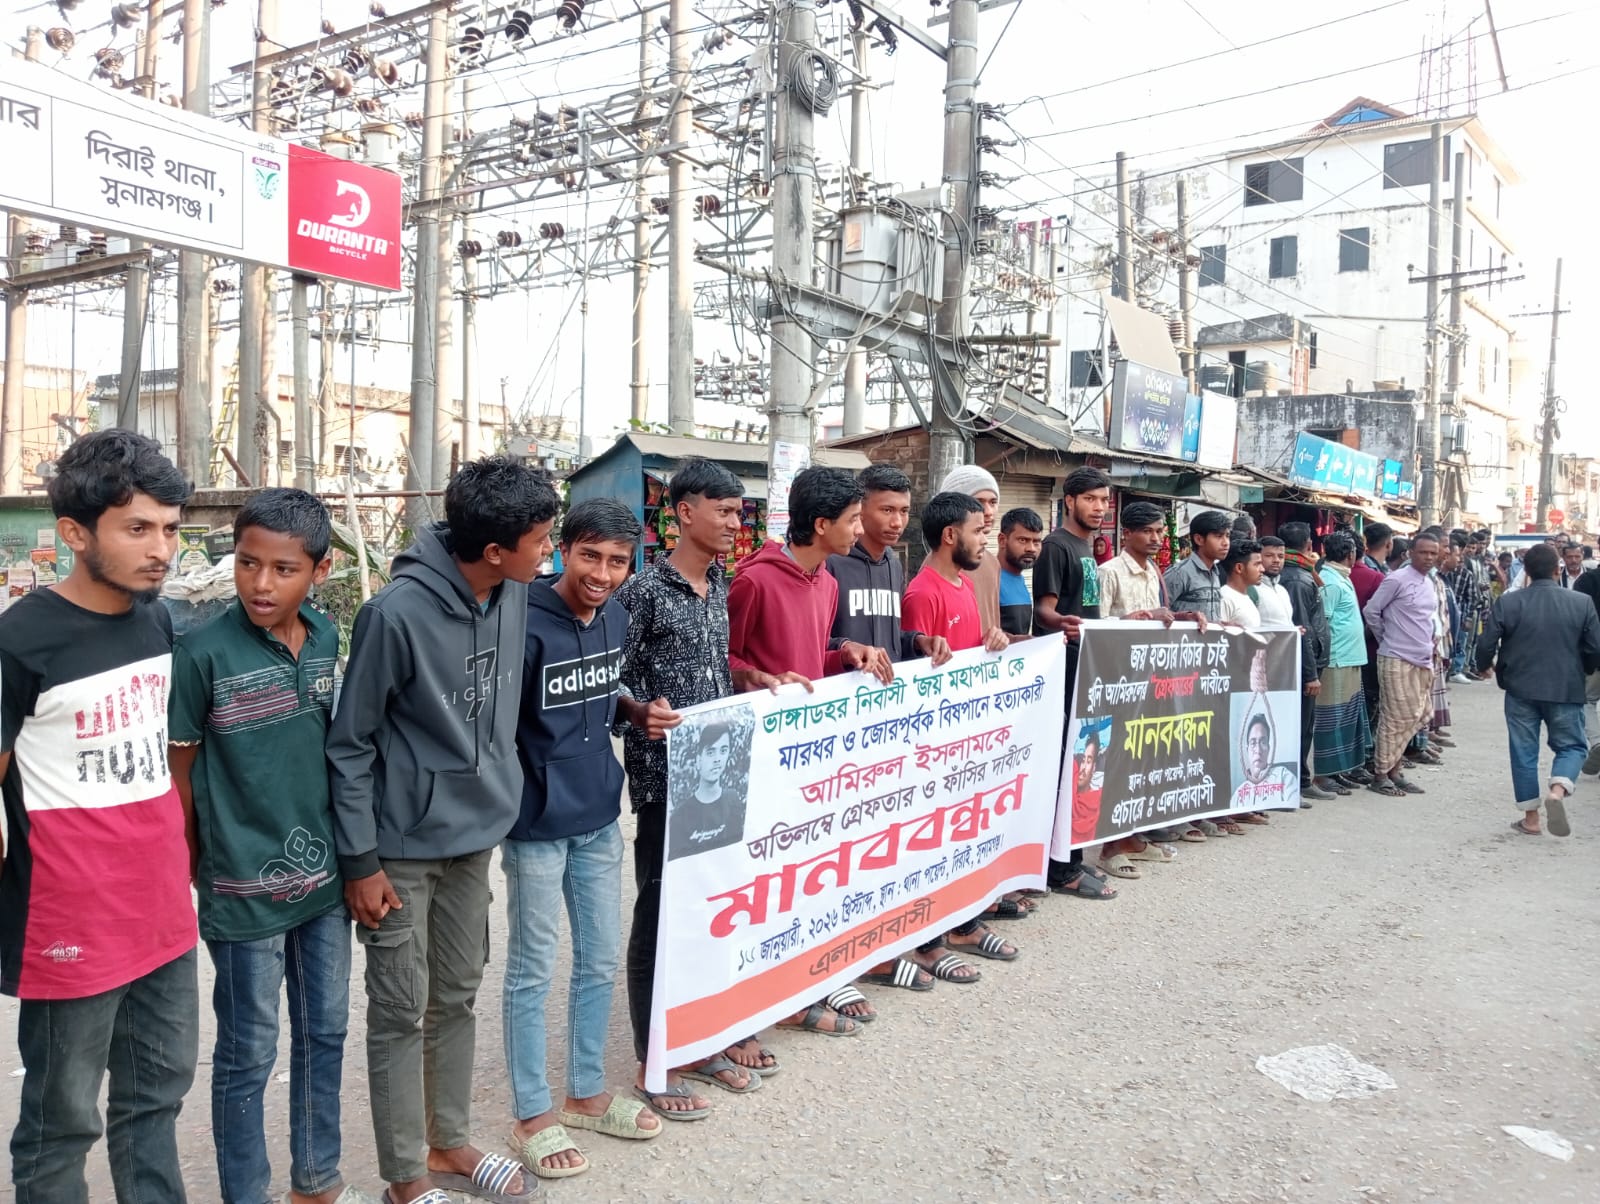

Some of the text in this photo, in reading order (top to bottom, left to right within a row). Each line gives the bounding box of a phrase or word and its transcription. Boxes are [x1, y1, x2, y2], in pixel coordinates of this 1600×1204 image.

[84, 130, 225, 197] দিরাই থানা,
[297, 218, 388, 256] DURANTA
[329, 246, 367, 260] BICYCLE
[1130, 634, 1230, 672] জয় হত্যার বিচার চাই
[1200, 668, 1231, 696] দাবীতে
[762, 697, 850, 733] ভাঙ্গাডহর
[855, 678, 907, 715] নিবাসী
[1008, 657, 1025, 677] কে
[778, 675, 1045, 771] মারধর ও জোরপূর্বক বিষপানে হত্যাকারী
[799, 725, 1013, 805] আমিরুল ইসলামকে
[1124, 711, 1214, 760] মানববন্ধন
[747, 812, 835, 862] অভিলম্বে
[841, 785, 917, 830] গ্রেফতার
[922, 780, 936, 799] ও
[943, 760, 988, 793] ফাঁসির
[992, 743, 1033, 776] দাবীতে
[1111, 796, 1146, 828] প্রচারে
[1157, 774, 1216, 814] এলাকাবাসী
[706, 773, 1029, 938] মানববন্ধন
[809, 909, 838, 940] ২০২৬
[904, 870, 922, 893] থানা
[809, 898, 936, 976] এলাকাবাসী
